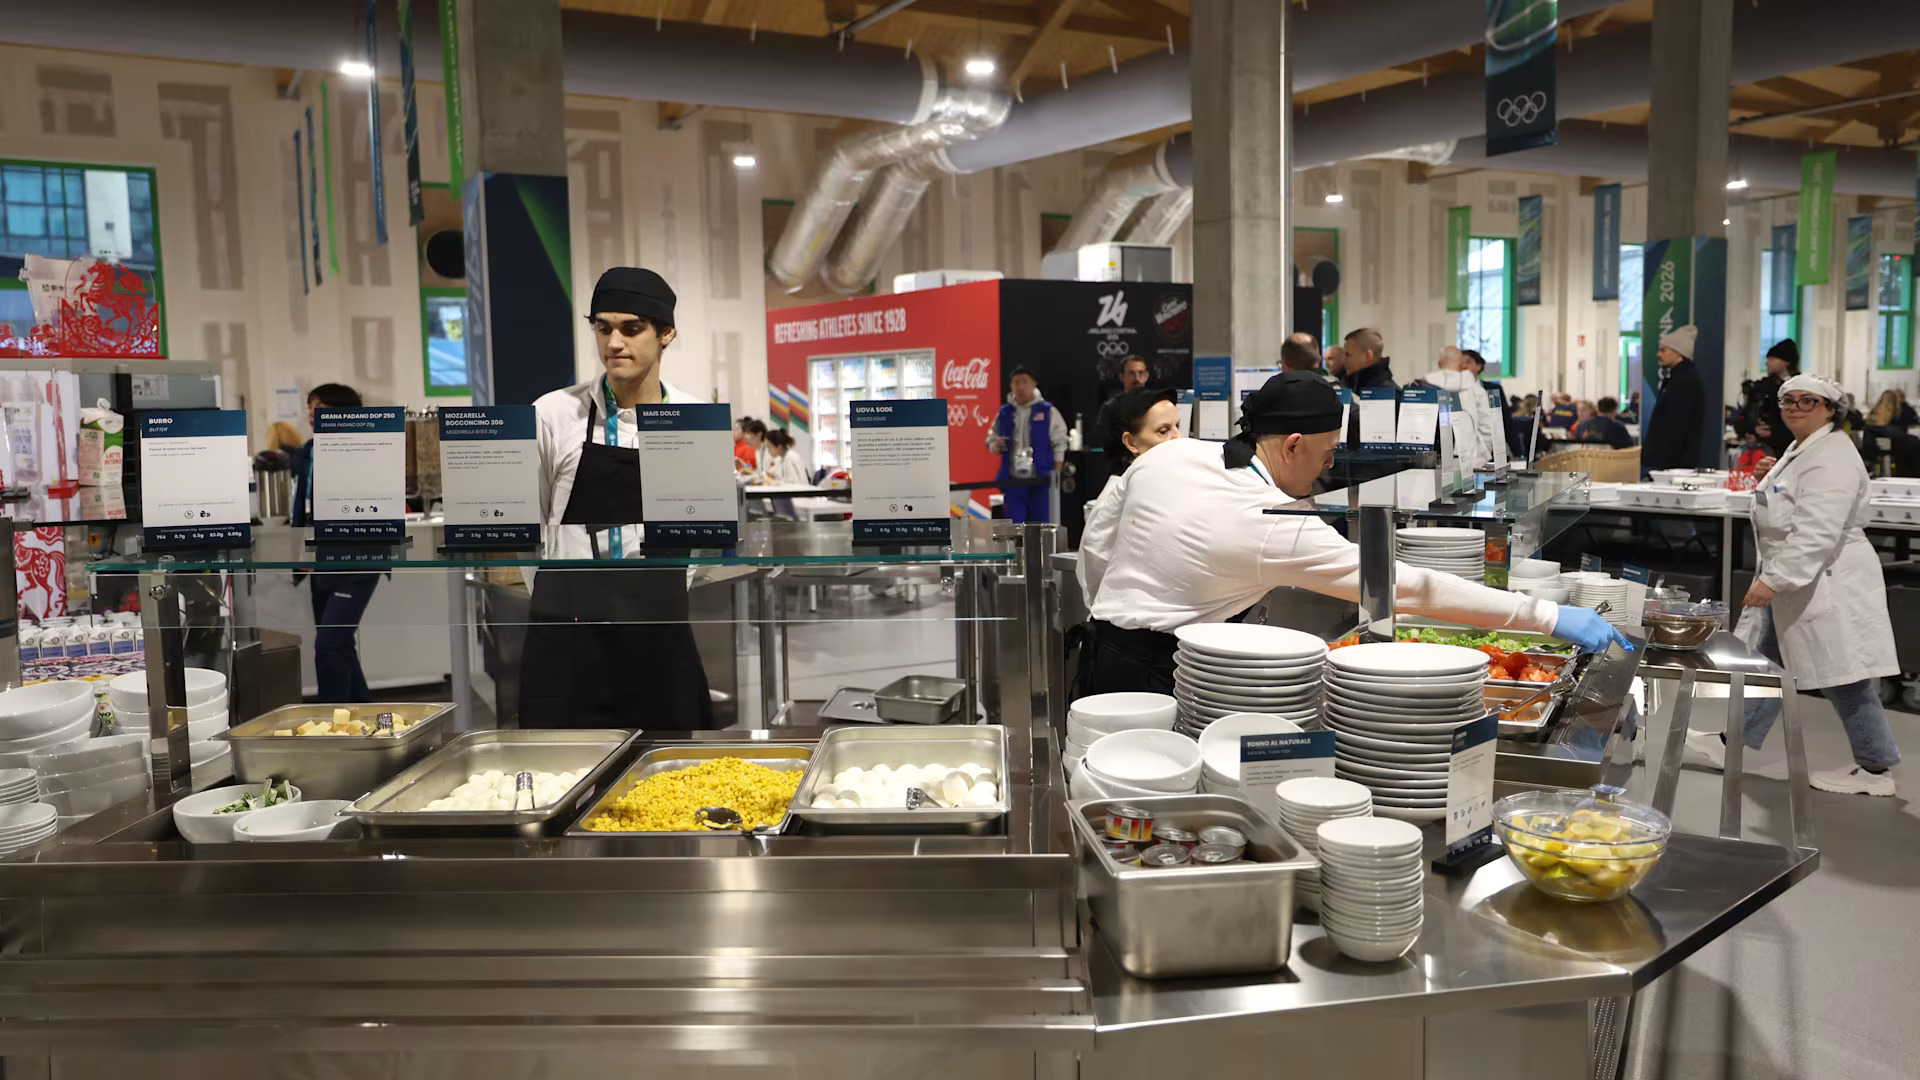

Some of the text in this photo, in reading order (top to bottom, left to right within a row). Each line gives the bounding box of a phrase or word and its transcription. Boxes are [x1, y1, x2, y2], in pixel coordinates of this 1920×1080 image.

[1660, 260, 1675, 303] 2026
[774, 307, 906, 344] REFRESHING ATHLETES SINCE 1928
